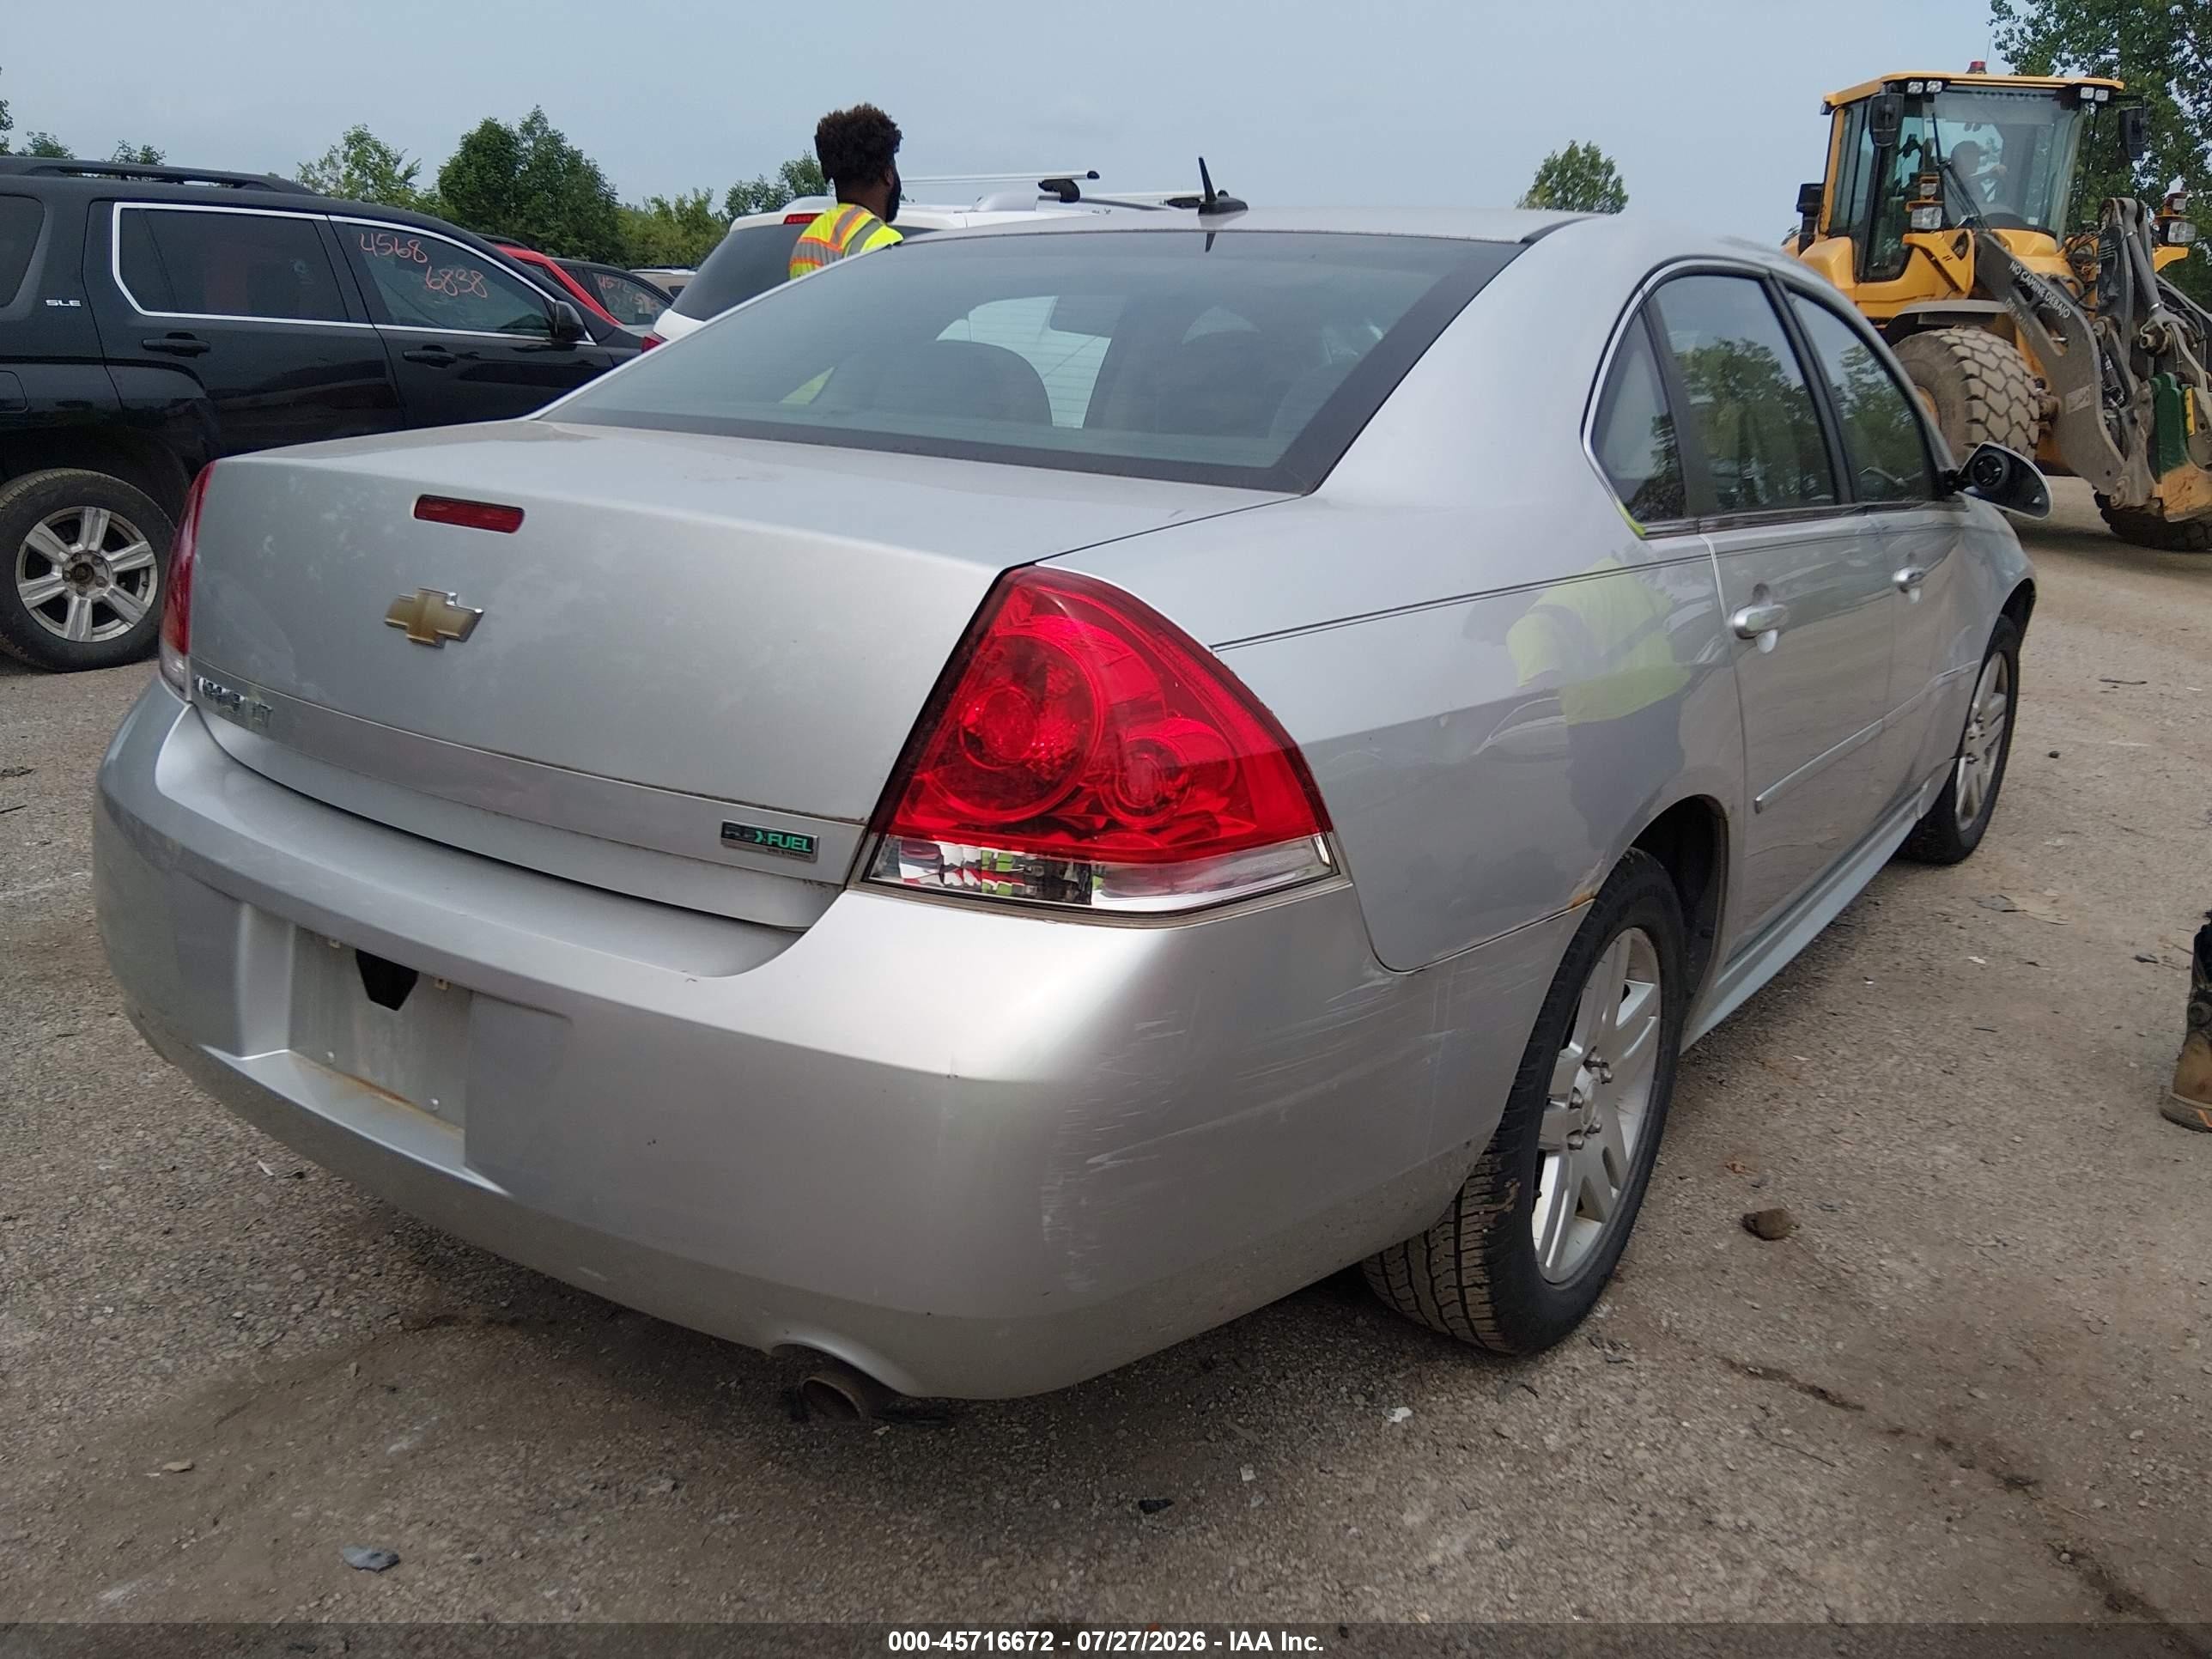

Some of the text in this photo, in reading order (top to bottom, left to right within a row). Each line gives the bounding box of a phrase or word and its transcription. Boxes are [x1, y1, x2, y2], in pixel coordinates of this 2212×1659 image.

[360, 233, 428, 264] 4568
[425, 264, 488, 299] 6838
[2008, 260, 2071, 319] NO CAMINE DEBAJO
[767, 833, 812, 853] FUEL
